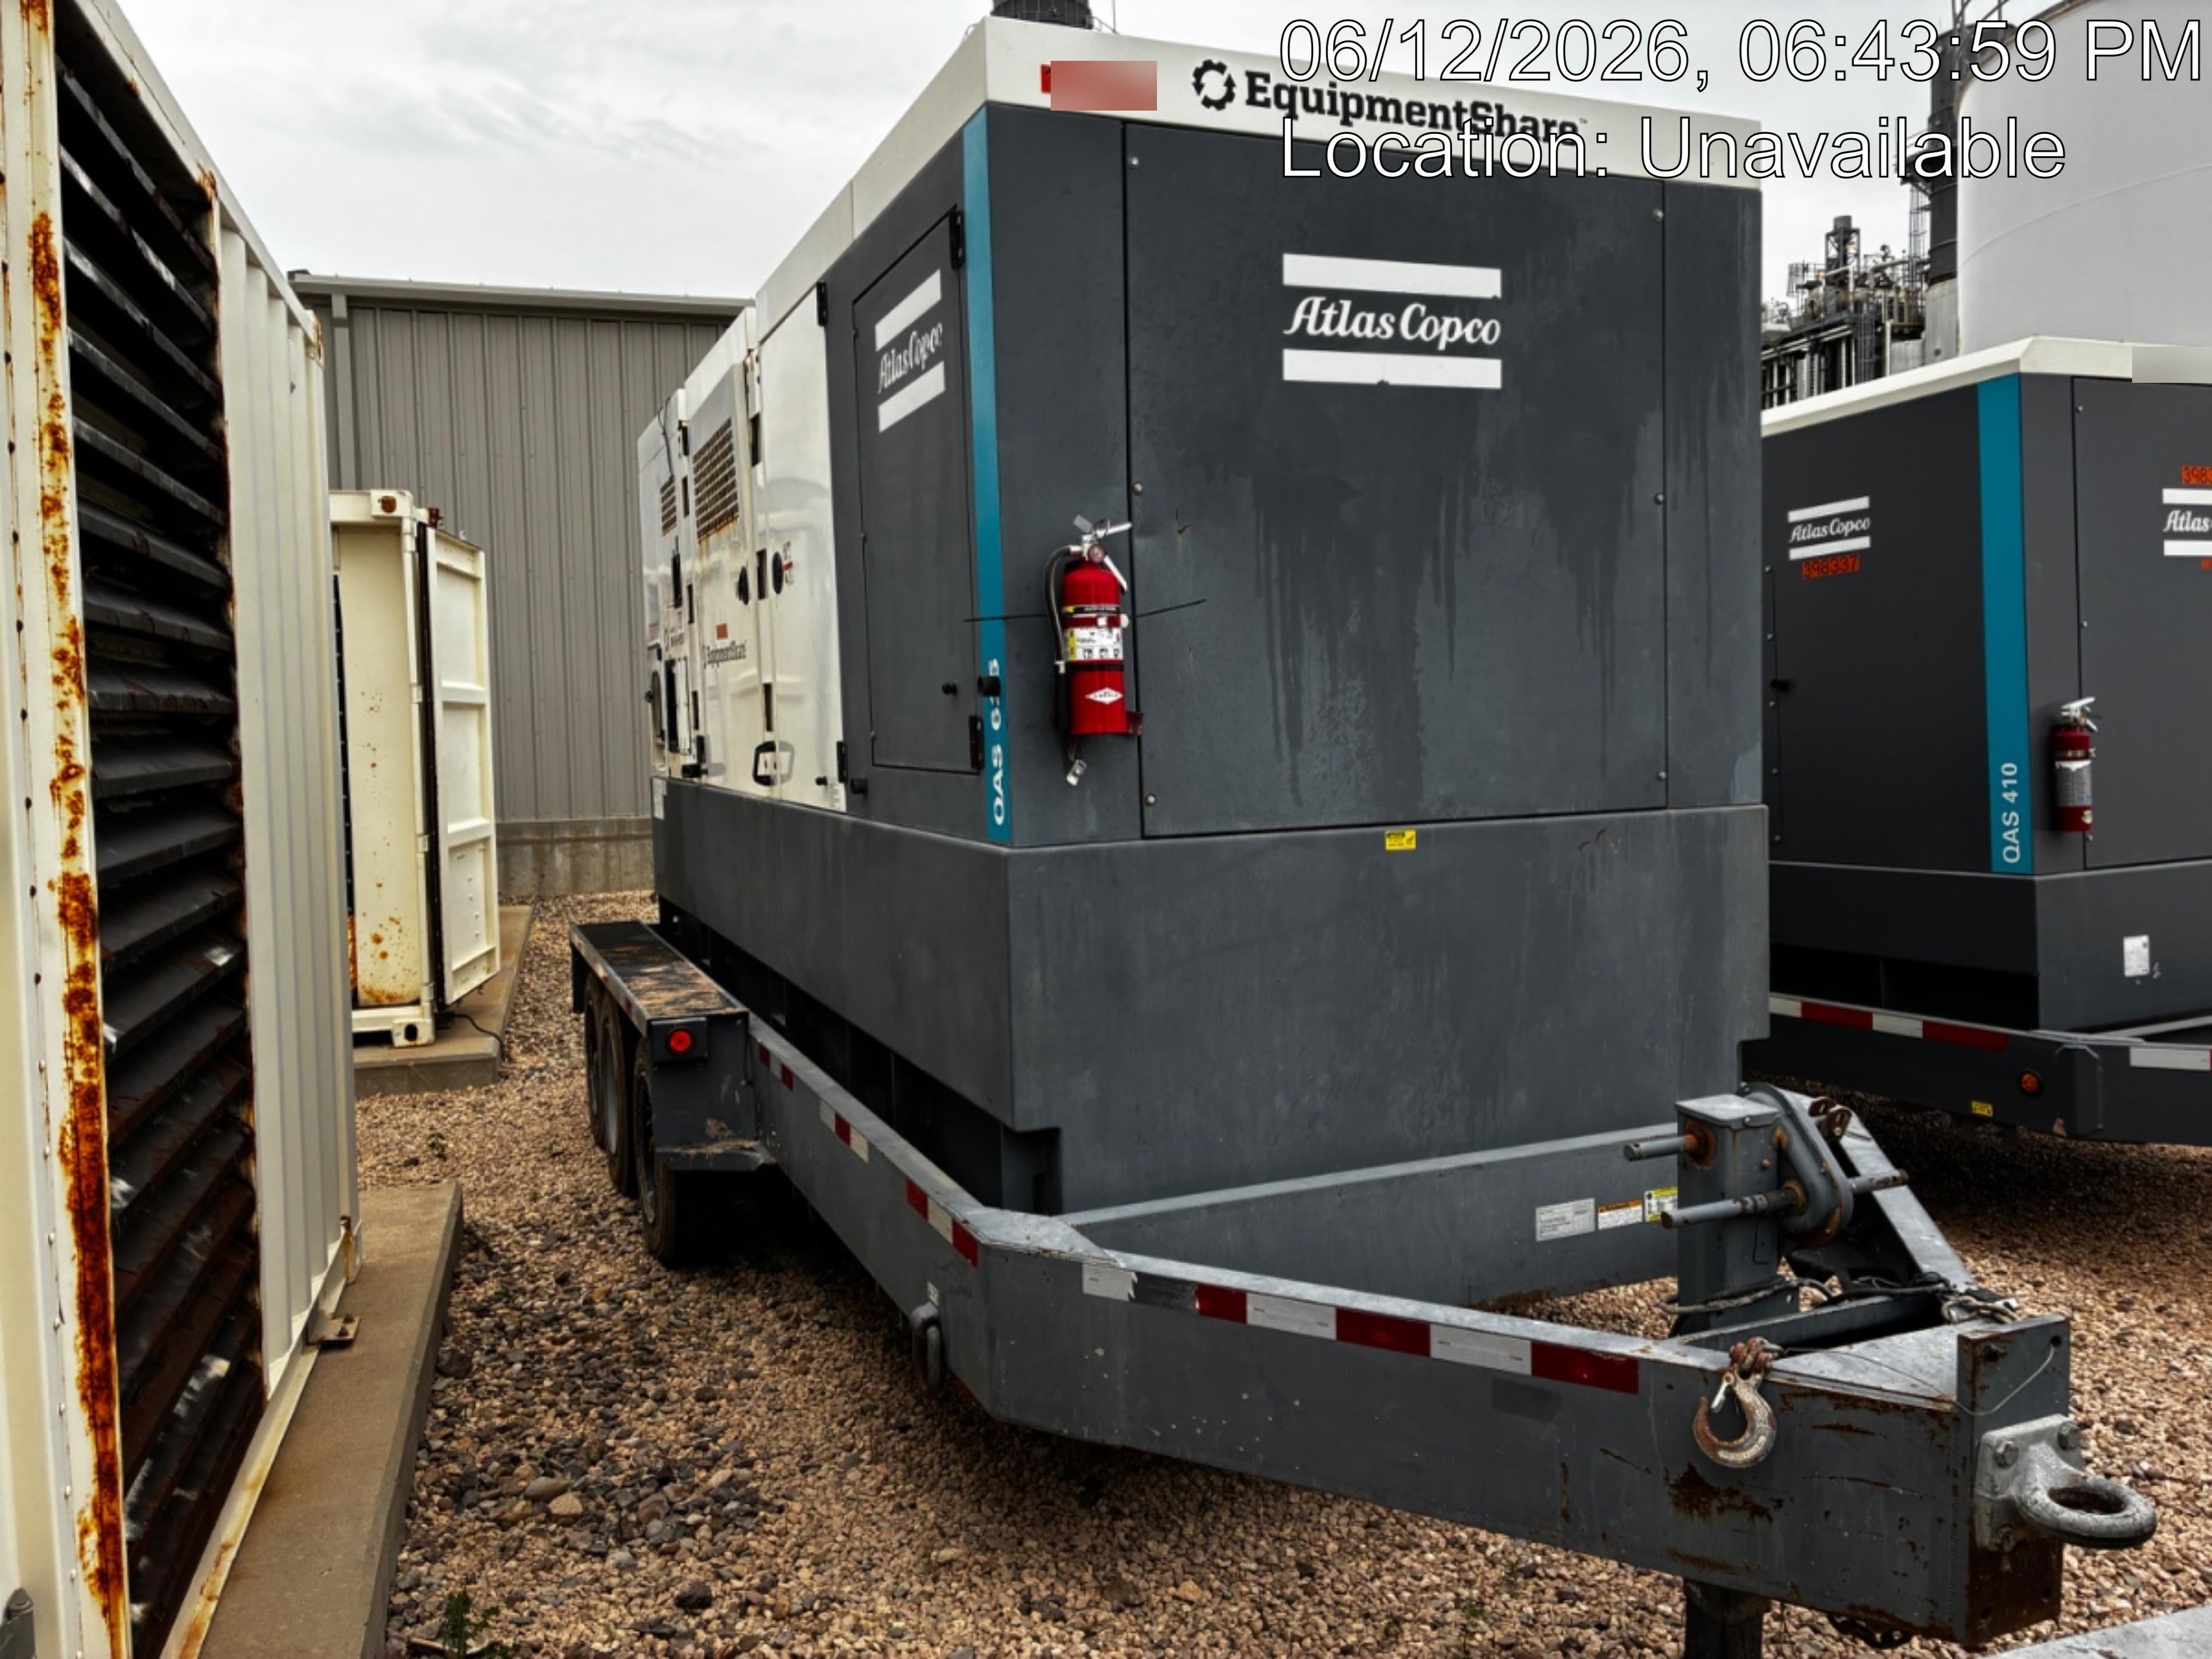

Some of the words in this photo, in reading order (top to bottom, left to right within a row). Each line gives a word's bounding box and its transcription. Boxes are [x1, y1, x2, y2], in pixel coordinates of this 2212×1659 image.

[1284, 296, 1395, 339] Atlas
[1400, 302, 1501, 351] Copco
[877, 347, 909, 394] Atlas
[1789, 523, 1828, 543] Atlas
[1829, 517, 1870, 536] Copco
[2162, 509, 2210, 533] Atlas
[2001, 763, 2019, 804] 410
[2002, 811, 2020, 863] QAS
